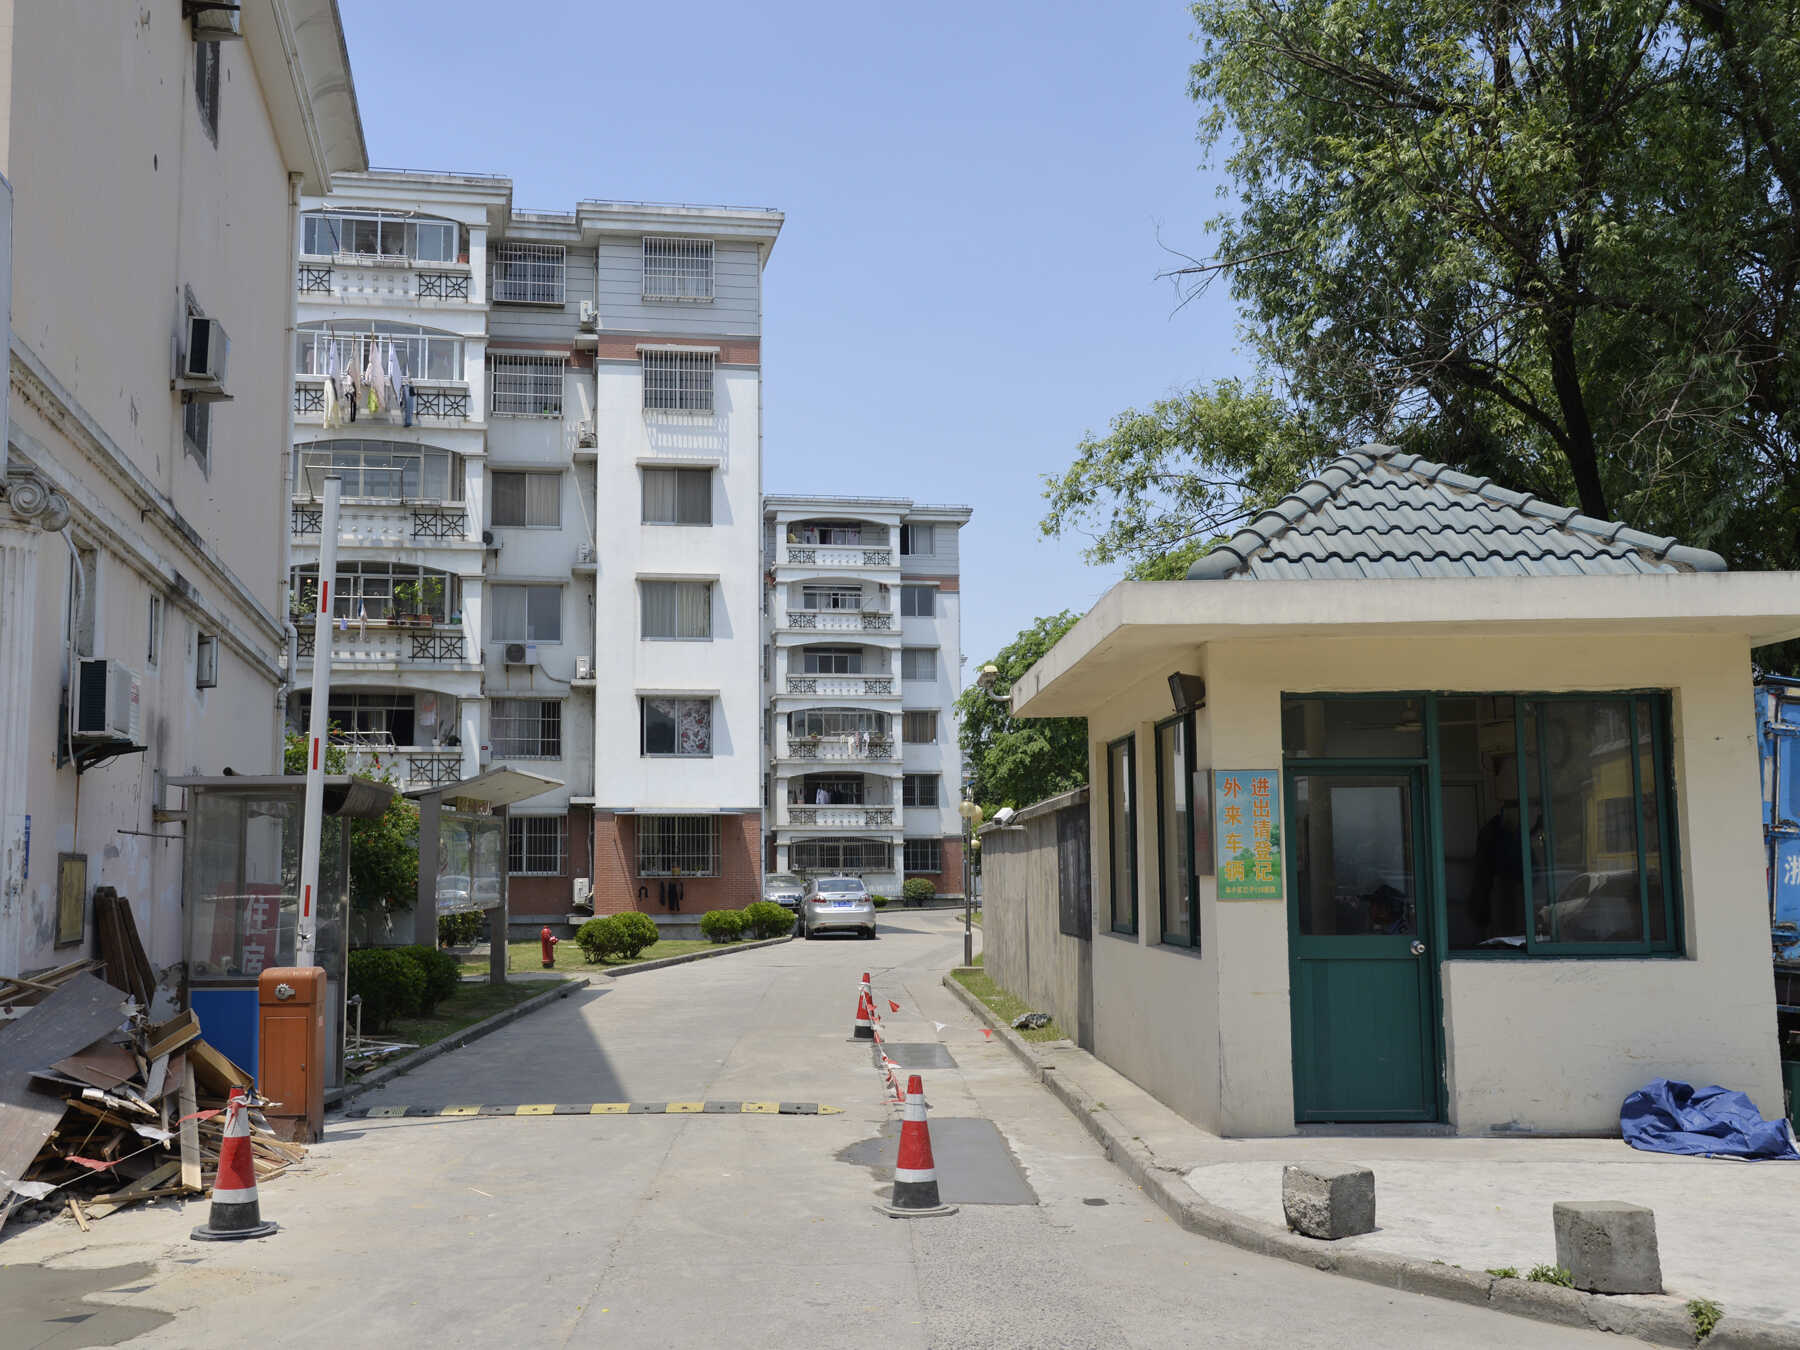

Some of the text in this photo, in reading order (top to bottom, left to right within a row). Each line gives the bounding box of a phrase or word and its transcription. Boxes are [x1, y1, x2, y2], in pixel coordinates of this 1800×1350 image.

[1224, 777, 1245, 881] 外来车辆
[1251, 777, 1273, 881] 进出请登记
